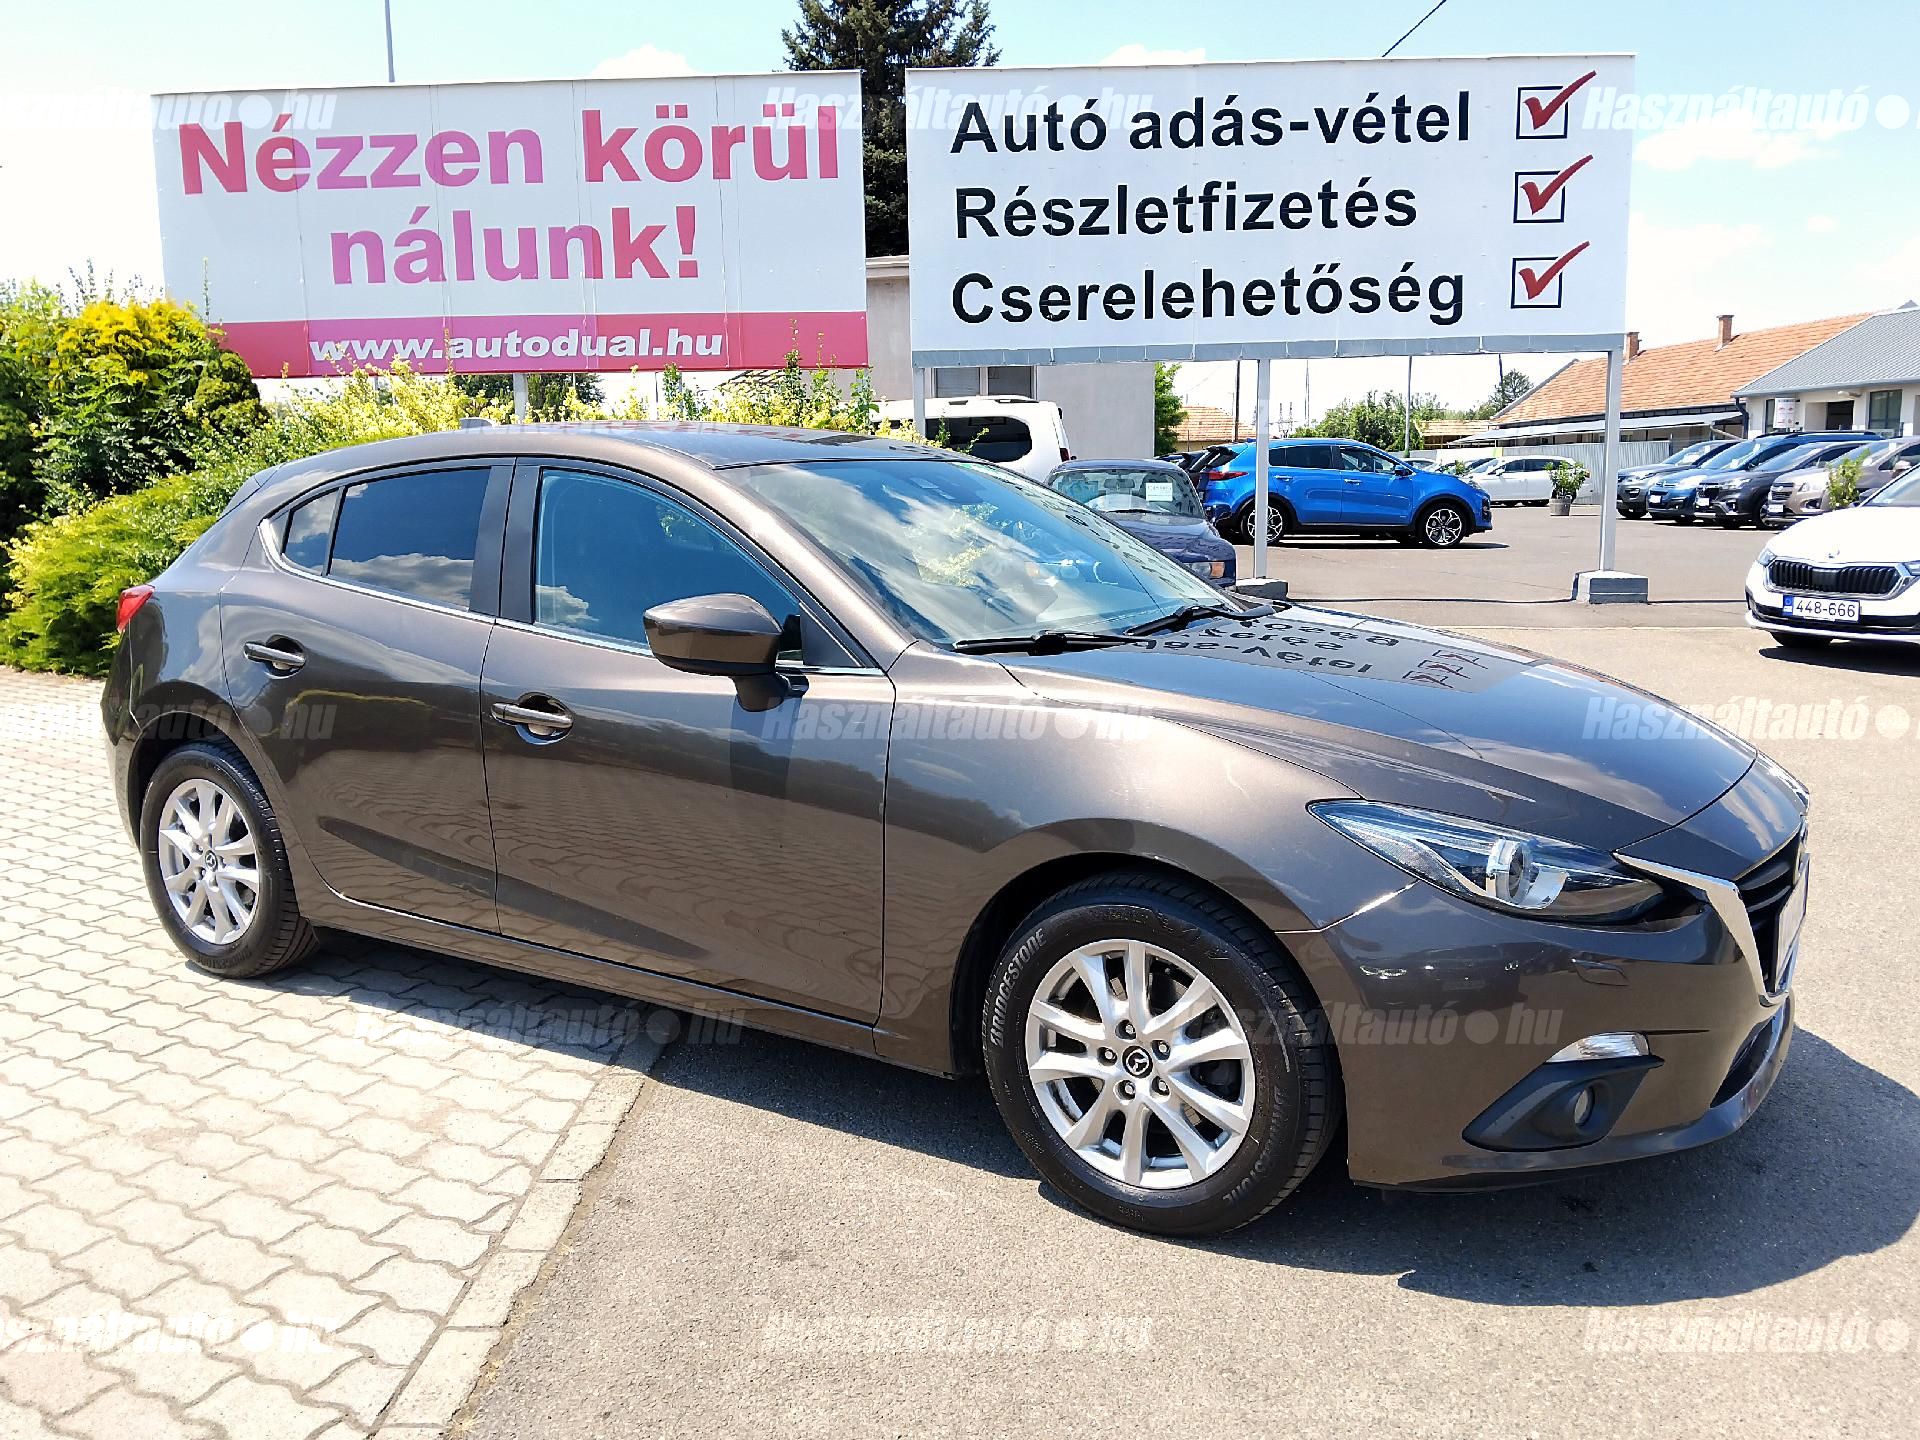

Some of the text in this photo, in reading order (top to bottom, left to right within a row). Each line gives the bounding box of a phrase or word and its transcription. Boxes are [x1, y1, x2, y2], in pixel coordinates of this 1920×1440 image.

[180, 104, 839, 194] Nézzen körül
[950, 90, 1470, 154] Autó adás-vétel
[956, 176, 1418, 239] Részletfizetés
[331, 206, 700, 284] nálunk!
[952, 261, 1464, 326] Cserelehetőség
[309, 328, 723, 361] www.autodual.hu
[1796, 600, 1856, 618] 448-666
[990, 927, 1048, 1048] BRIDGESTONE
